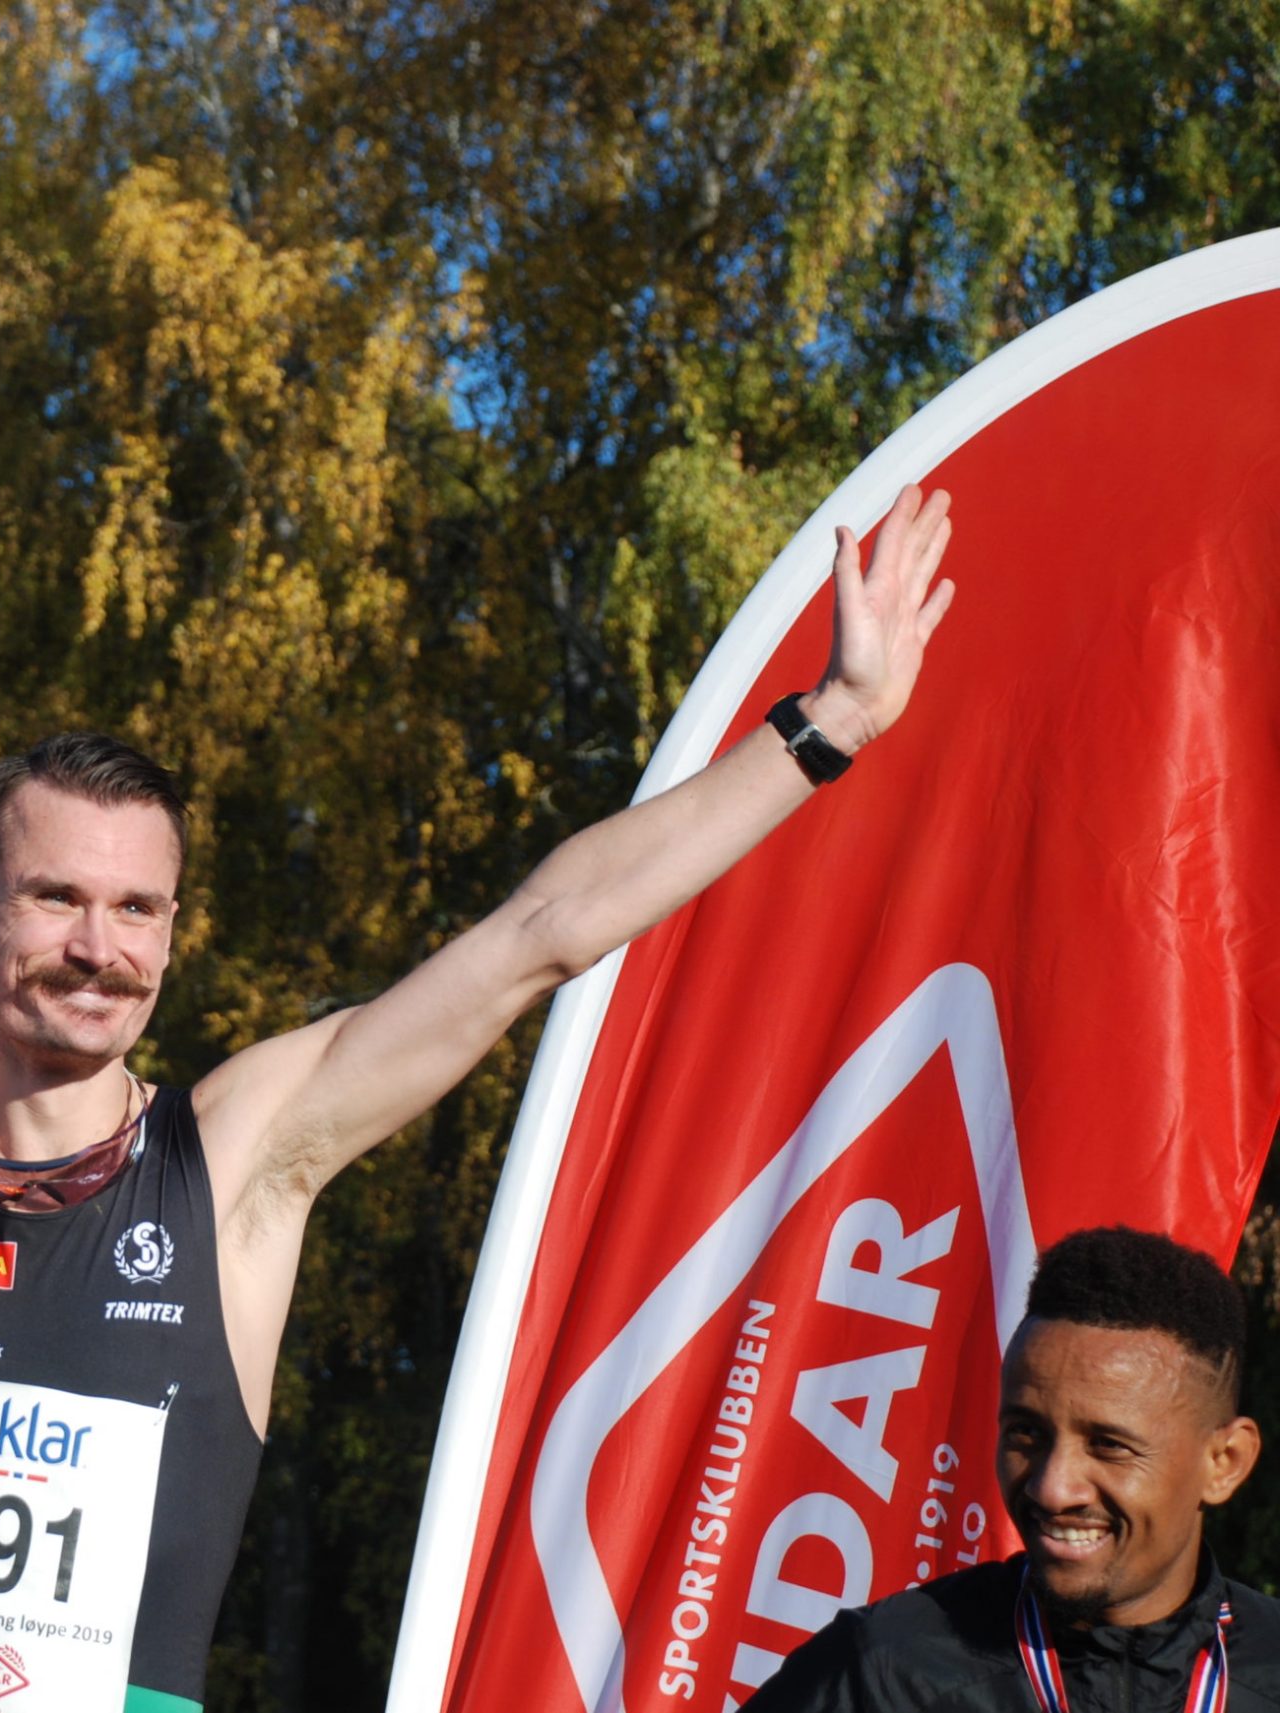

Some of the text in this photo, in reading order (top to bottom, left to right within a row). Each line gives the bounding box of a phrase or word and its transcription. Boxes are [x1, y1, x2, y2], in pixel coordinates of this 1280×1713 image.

[104, 1302, 184, 1324] TRIMTEX
[658, 1299, 776, 1700] SPORTSKLUBBEN
[721, 1197, 961, 1713] IDAR
[915, 1443, 960, 1549] 1919
[20, 1614, 67, 1638] løype
[72, 1624, 113, 1645] 2019
